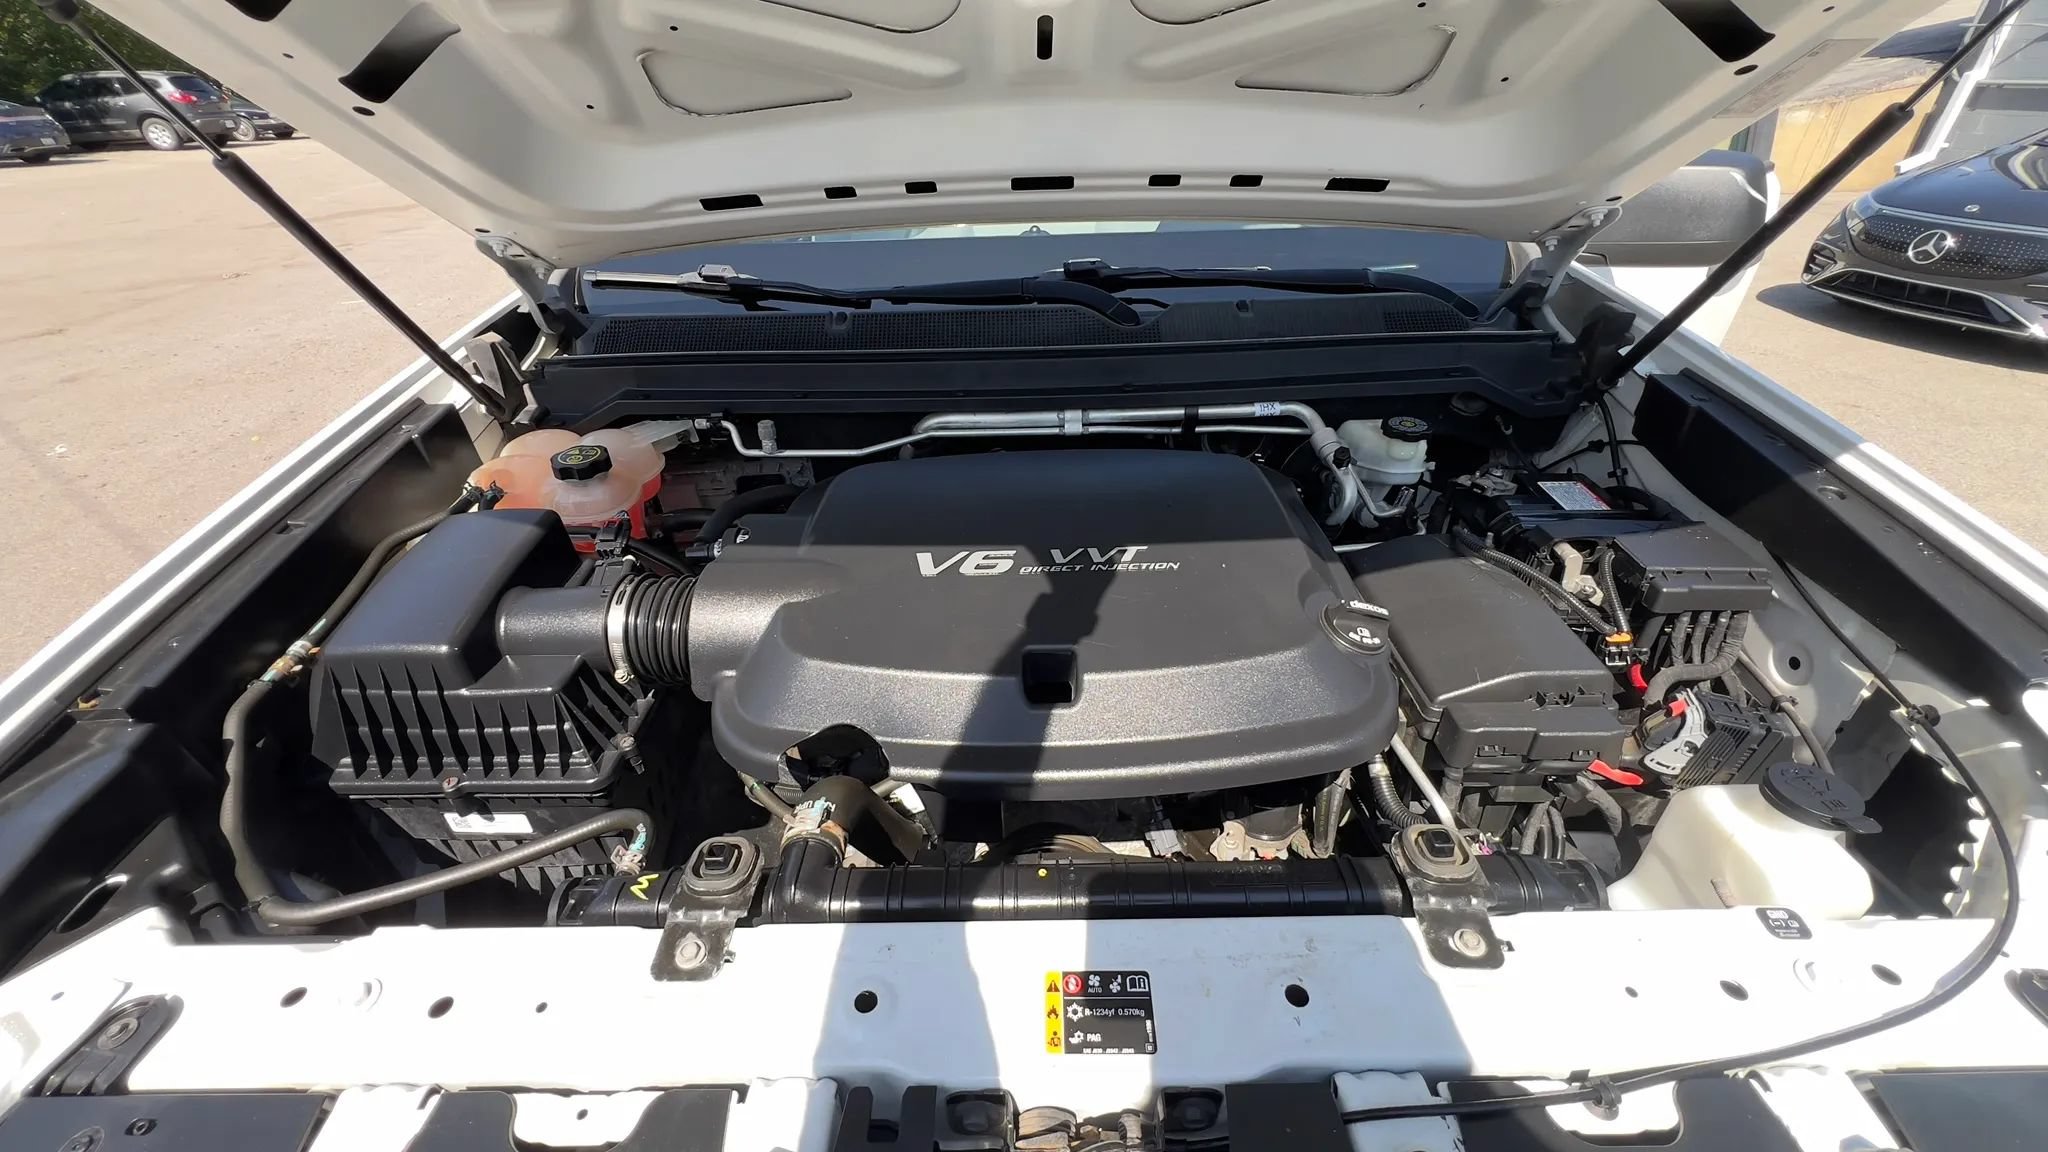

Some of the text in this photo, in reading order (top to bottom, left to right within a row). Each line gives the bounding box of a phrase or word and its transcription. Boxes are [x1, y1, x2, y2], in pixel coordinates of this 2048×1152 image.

[915, 545, 1148, 577] V6 VVT
[1019, 561, 1180, 575] DIRECT INJECTION
[1084, 1008, 1145, 1017] R-1234yf 0.570kg
[1086, 1033, 1102, 1042] PAG
